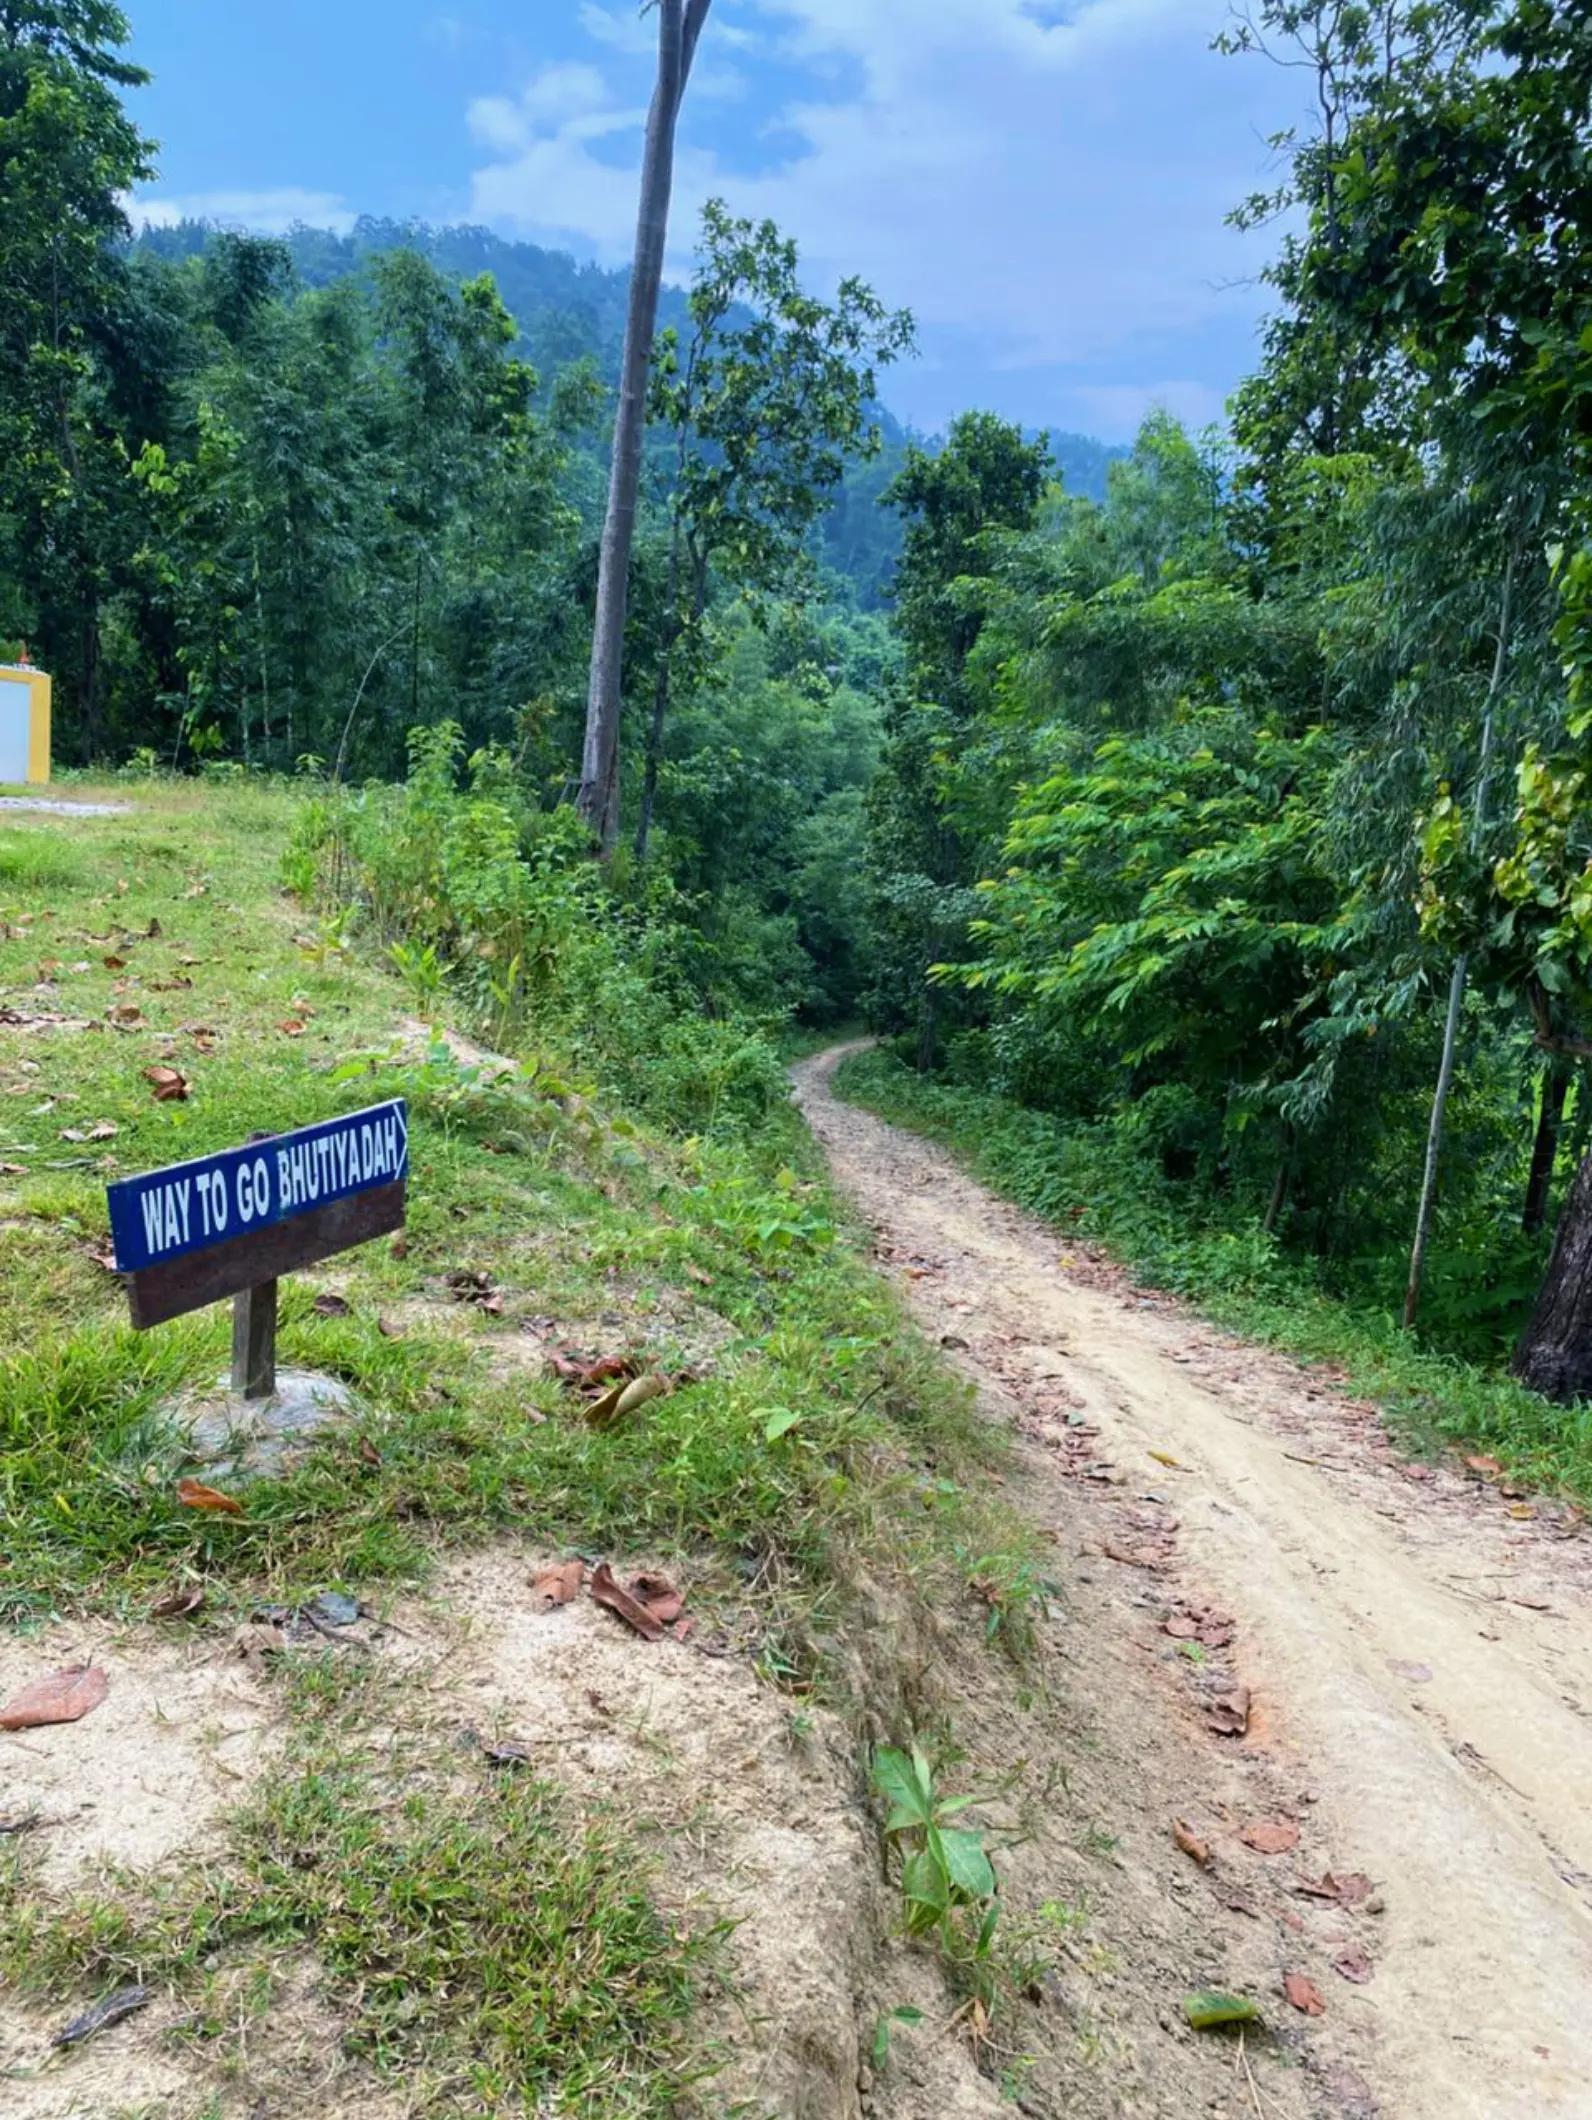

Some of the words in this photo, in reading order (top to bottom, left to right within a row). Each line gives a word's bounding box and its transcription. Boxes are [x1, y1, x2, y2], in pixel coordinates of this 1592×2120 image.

[141, 1179, 190, 1255] WAY
[196, 1169, 228, 1236] TO
[236, 1157, 270, 1223] GO
